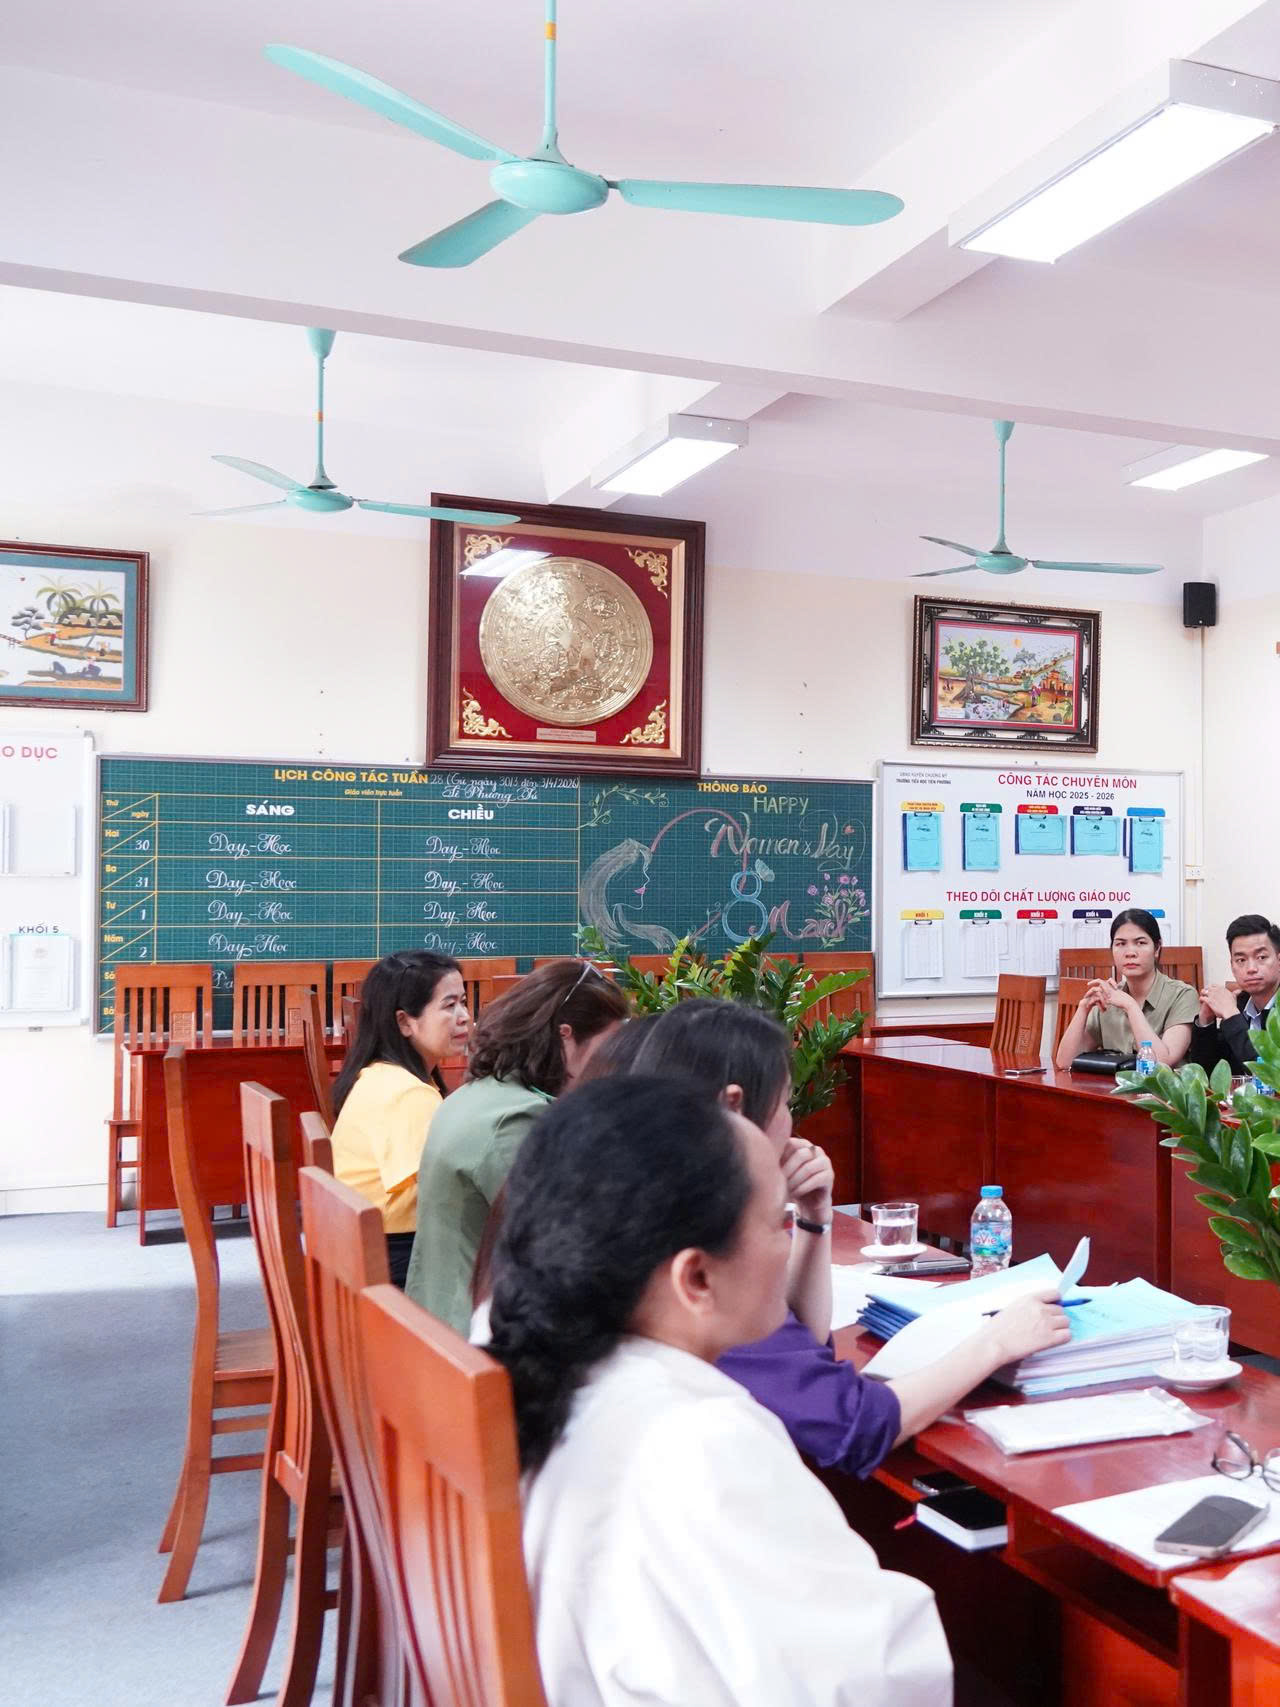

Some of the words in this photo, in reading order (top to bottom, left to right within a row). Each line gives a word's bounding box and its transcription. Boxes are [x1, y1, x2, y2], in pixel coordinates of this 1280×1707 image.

[22, 746, 58, 762] DỤC
[274, 769, 307, 783] LỊCH
[312, 769, 356, 782] CÔNG
[360, 770, 388, 783] TÁC
[392, 769, 428, 784] TUẦN
[431, 774, 442, 784] 28
[998, 772, 1032, 785] CÔNG
[1036, 773, 1057, 787] TÁC
[1062, 775, 1108, 788] CHUYÊN
[1113, 776, 1136, 789] MÔN
[697, 781, 739, 793] THÔNG
[743, 782, 767, 794] BÁO
[1027, 788, 1046, 798] NĂM
[1049, 790, 1067, 800] HỌC
[1070, 791, 1089, 799] 2025
[246, 800, 295, 816] SÁNG
[753, 796, 809, 815] HAPPY
[448, 804, 494, 820] CHIỀU
[135, 839, 150, 851] 30
[135, 877, 148, 888] 31
[947, 891, 977, 901] THEO
[981, 889, 1000, 901] DÕI
[1004, 887, 1033, 901] CHẤT
[1038, 891, 1075, 904] LƯỢNG
[1079, 889, 1105, 901] GIÁO
[1109, 892, 1131, 903] DỤC
[139, 910, 146, 920] 1
[19, 923, 49, 934] KHỐI
[53, 925, 59, 934] 5
[104, 934, 124, 942] Năm
[139, 947, 147, 957] 2
